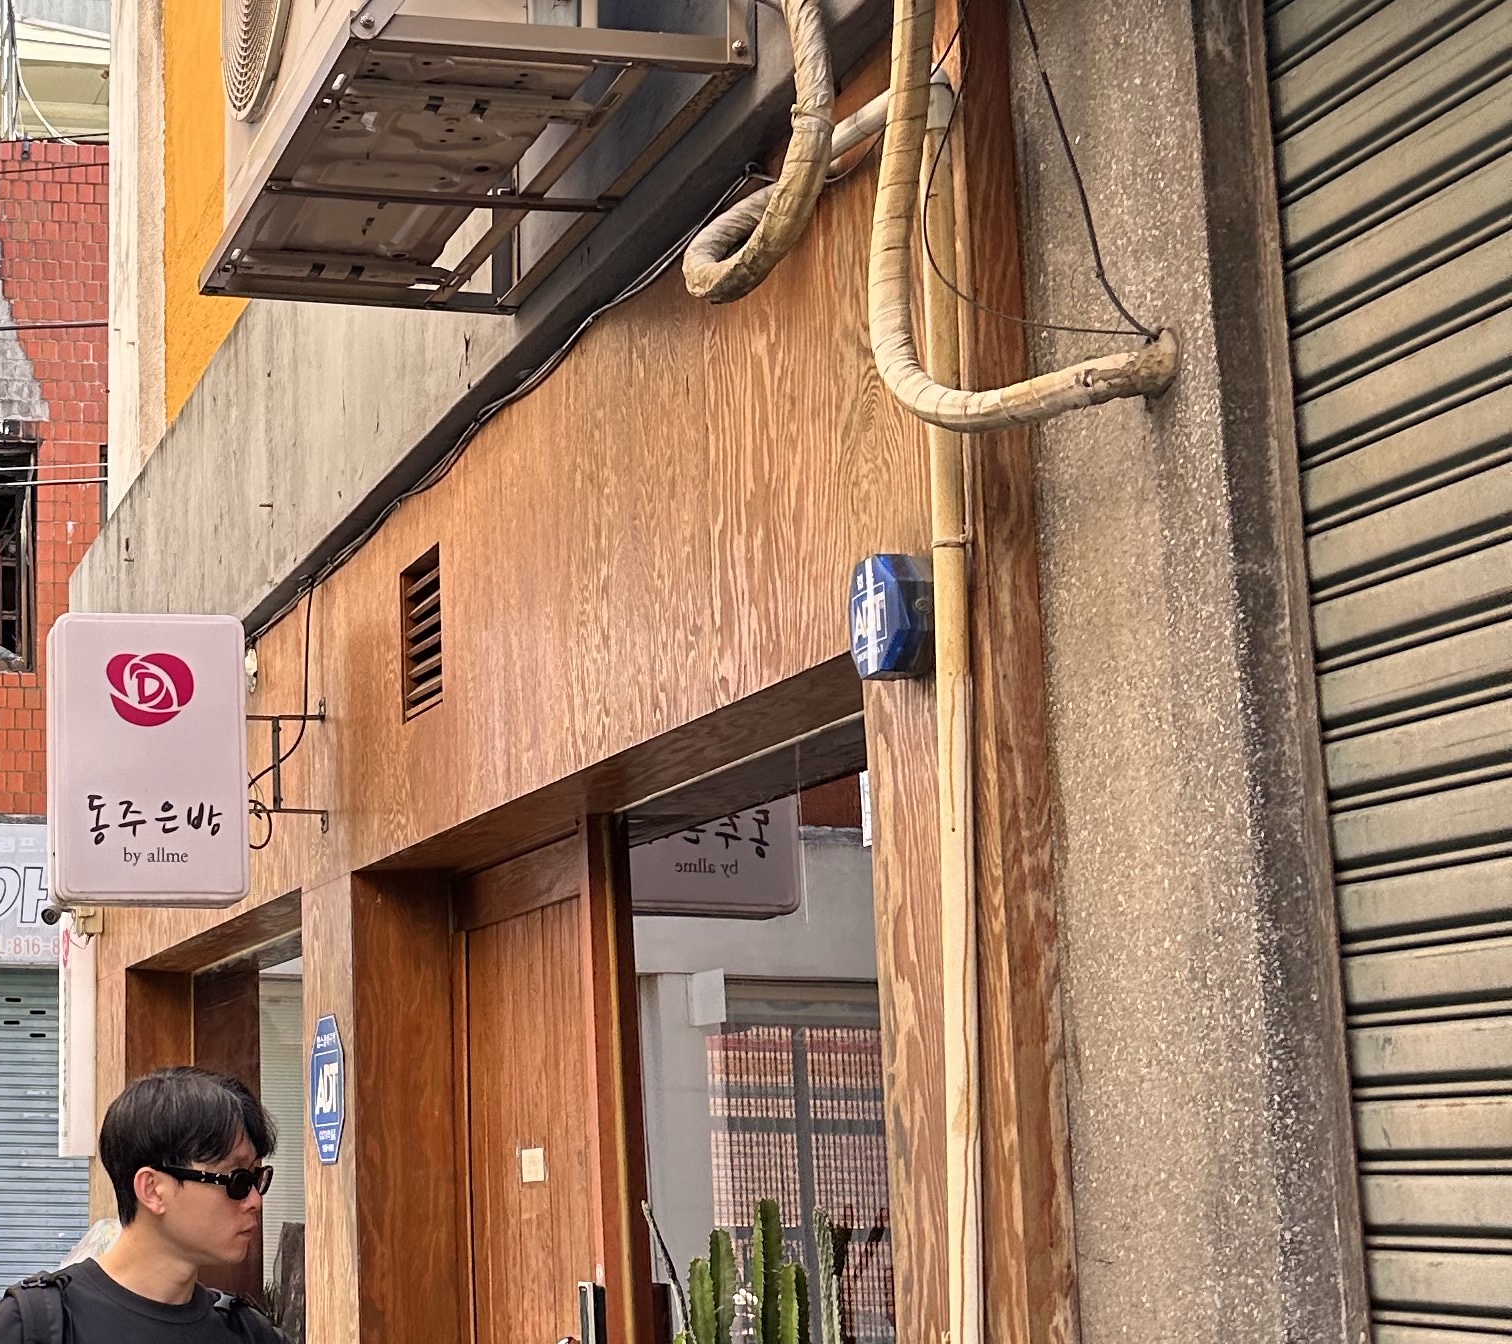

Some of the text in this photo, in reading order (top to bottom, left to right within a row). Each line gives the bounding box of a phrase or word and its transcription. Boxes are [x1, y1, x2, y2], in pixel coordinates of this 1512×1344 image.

[123, 846, 189, 866] by allme
[315, 1062, 339, 1115] ADT
